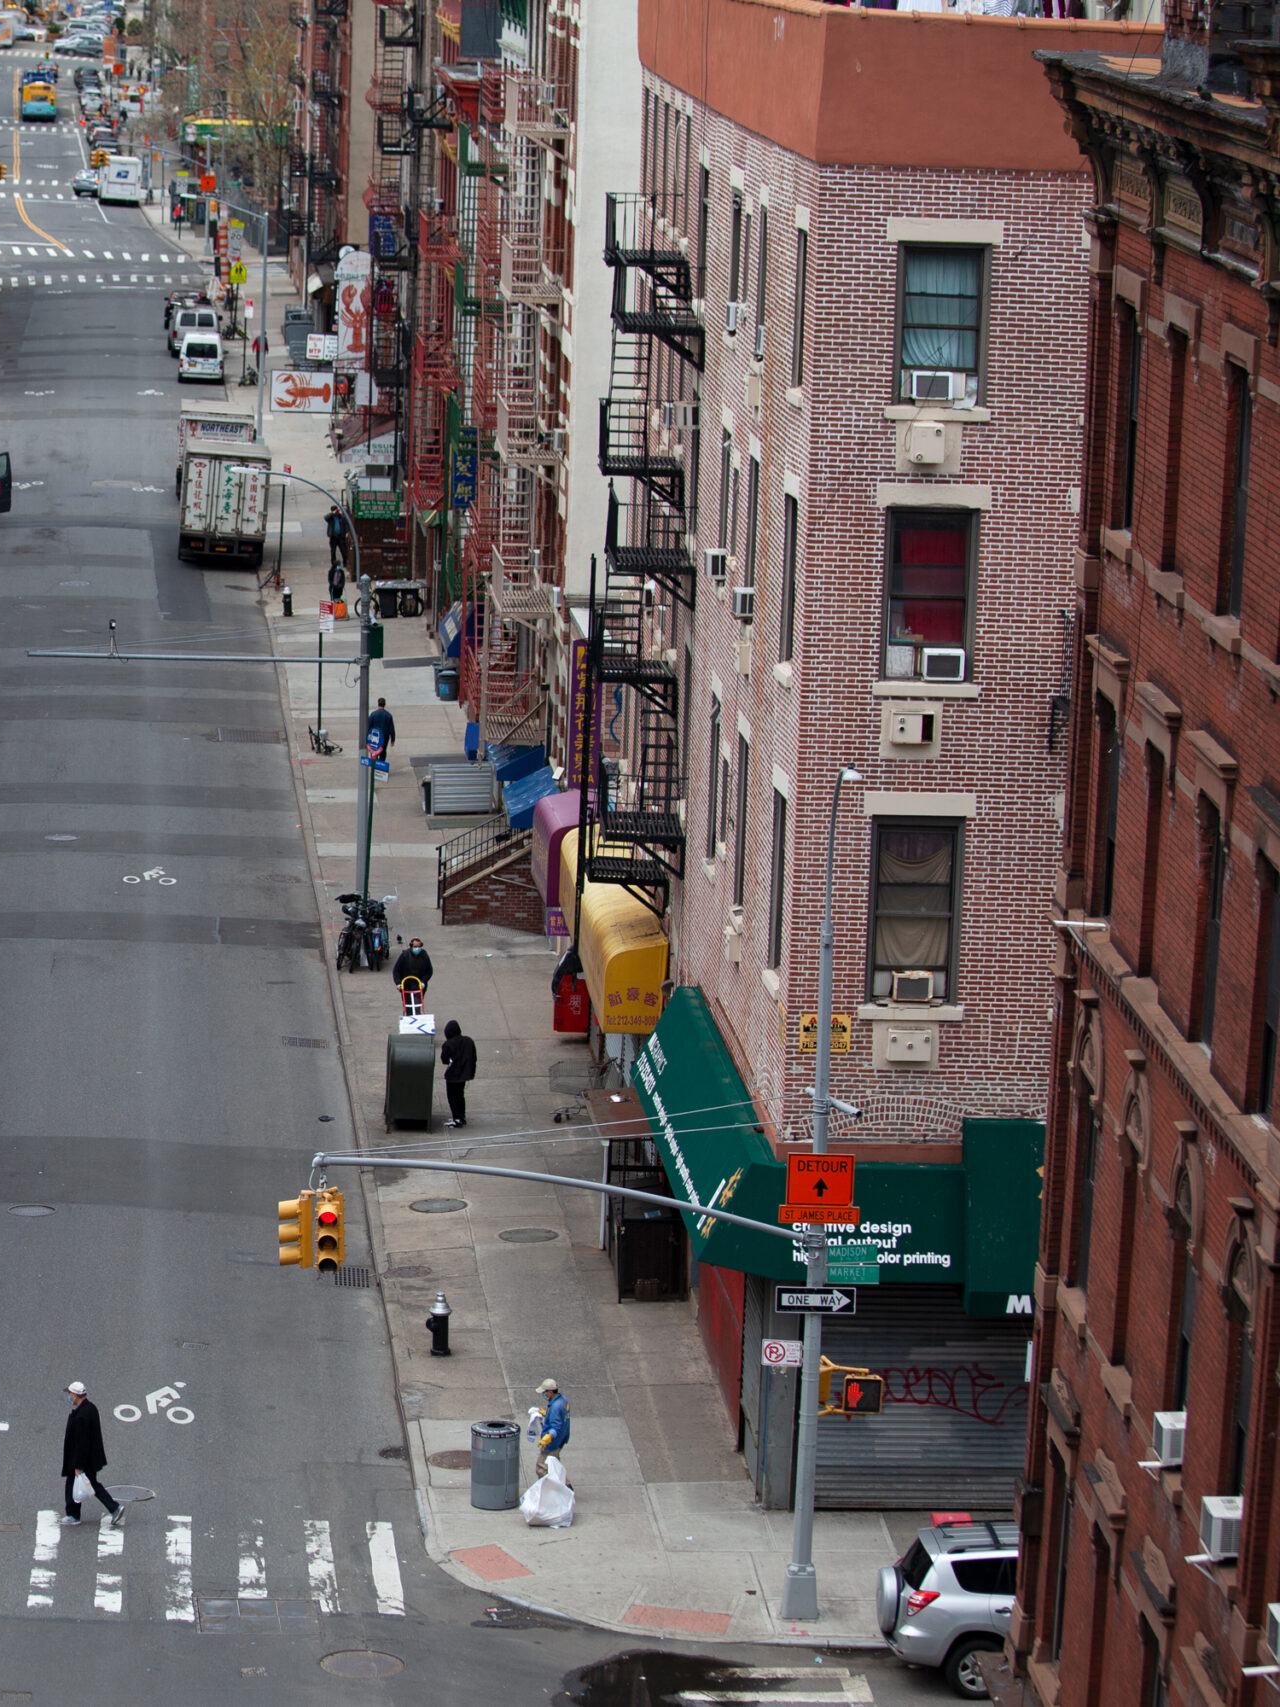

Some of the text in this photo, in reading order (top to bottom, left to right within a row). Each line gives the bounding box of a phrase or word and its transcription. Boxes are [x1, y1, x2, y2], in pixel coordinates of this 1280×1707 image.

[200, 423, 244, 434] NORTHEAST
[797, 1160, 848, 1173] DETOUR
[798, 1211, 825, 1220] JAMES
[827, 1211, 853, 1222] PLACE
[860, 1221, 912, 1237] design
[829, 1246, 867, 1257] MADISON
[876, 1253, 901, 1264] olor
[903, 1251, 951, 1268] printing
[830, 1267, 866, 1277] MARKET
[787, 1295, 844, 1306] ONE WAY
